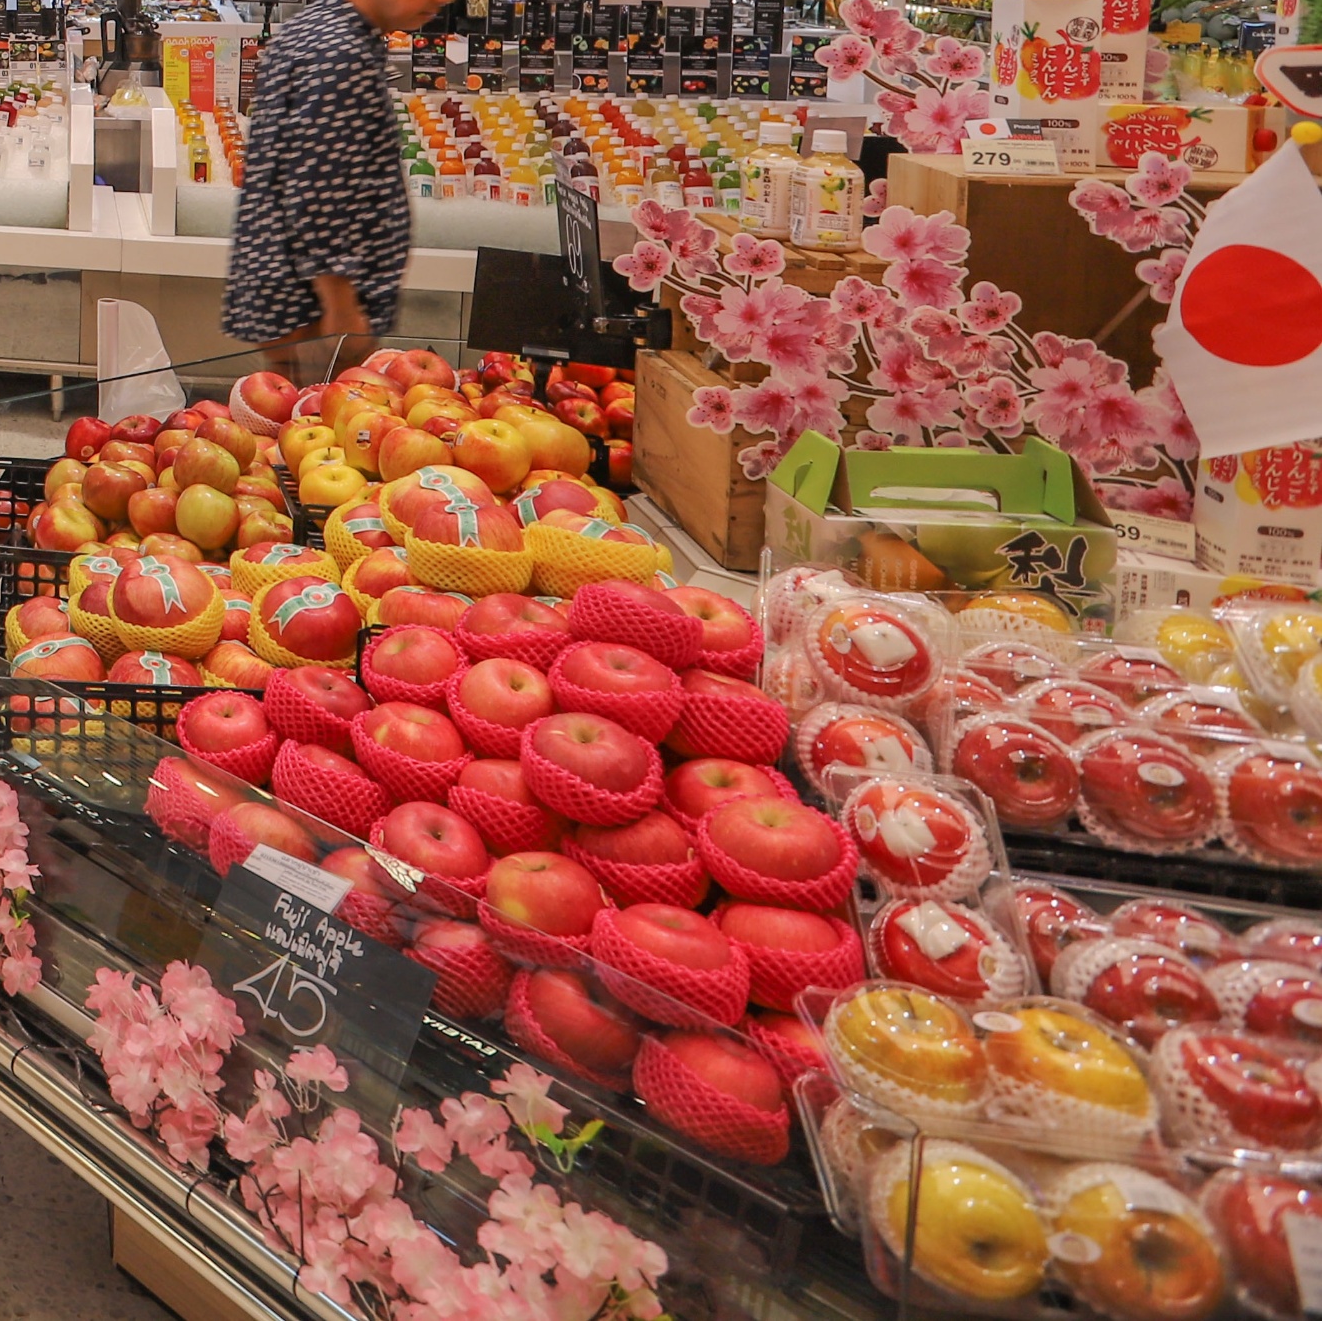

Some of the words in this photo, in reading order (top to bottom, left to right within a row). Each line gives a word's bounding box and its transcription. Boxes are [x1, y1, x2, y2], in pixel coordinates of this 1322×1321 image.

[1041, 46, 1058, 99] にんじん
[1047, 119, 1073, 128] 100%
[971, 151, 1011, 166] 279
[565, 214, 584, 279] 69
[314, 916, 365, 958] Apple
[232, 951, 338, 1038] 45
